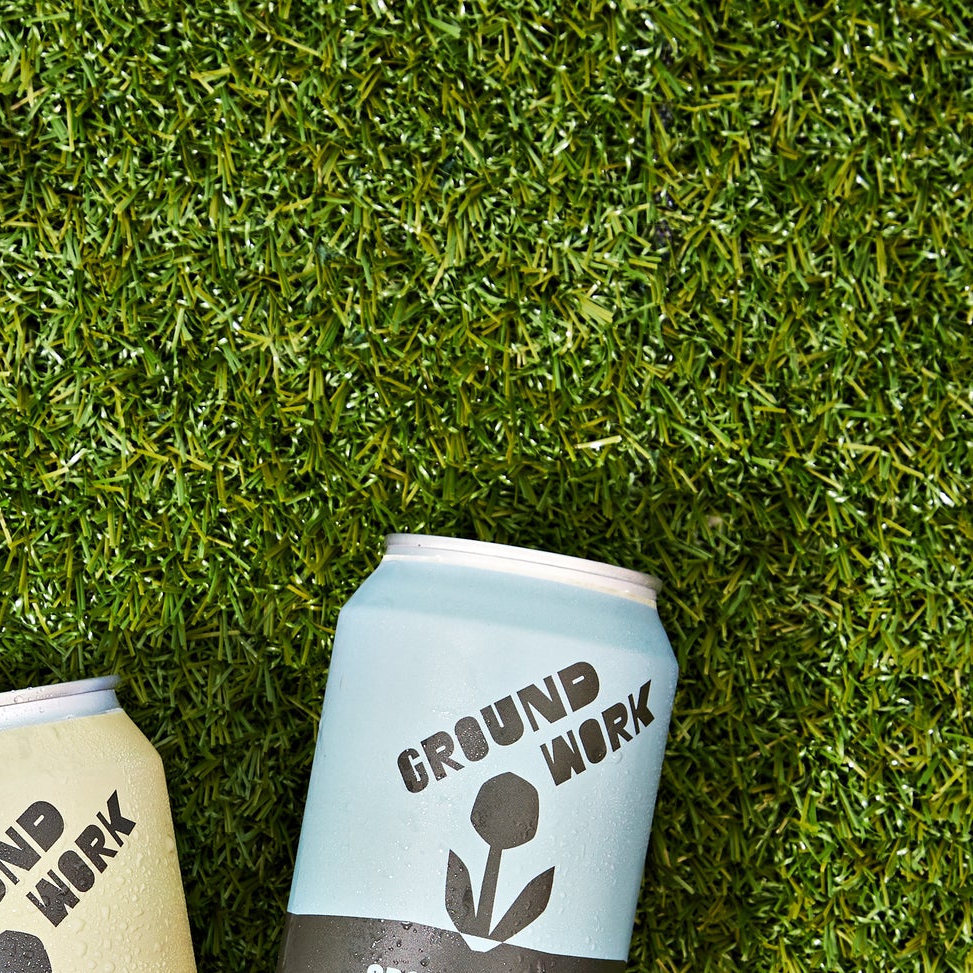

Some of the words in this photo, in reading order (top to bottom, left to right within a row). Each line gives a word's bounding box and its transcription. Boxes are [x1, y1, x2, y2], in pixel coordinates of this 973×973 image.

[397, 661, 600, 793] GROUND
[540, 679, 655, 786] WORK
[25, 789, 136, 927] WORK
